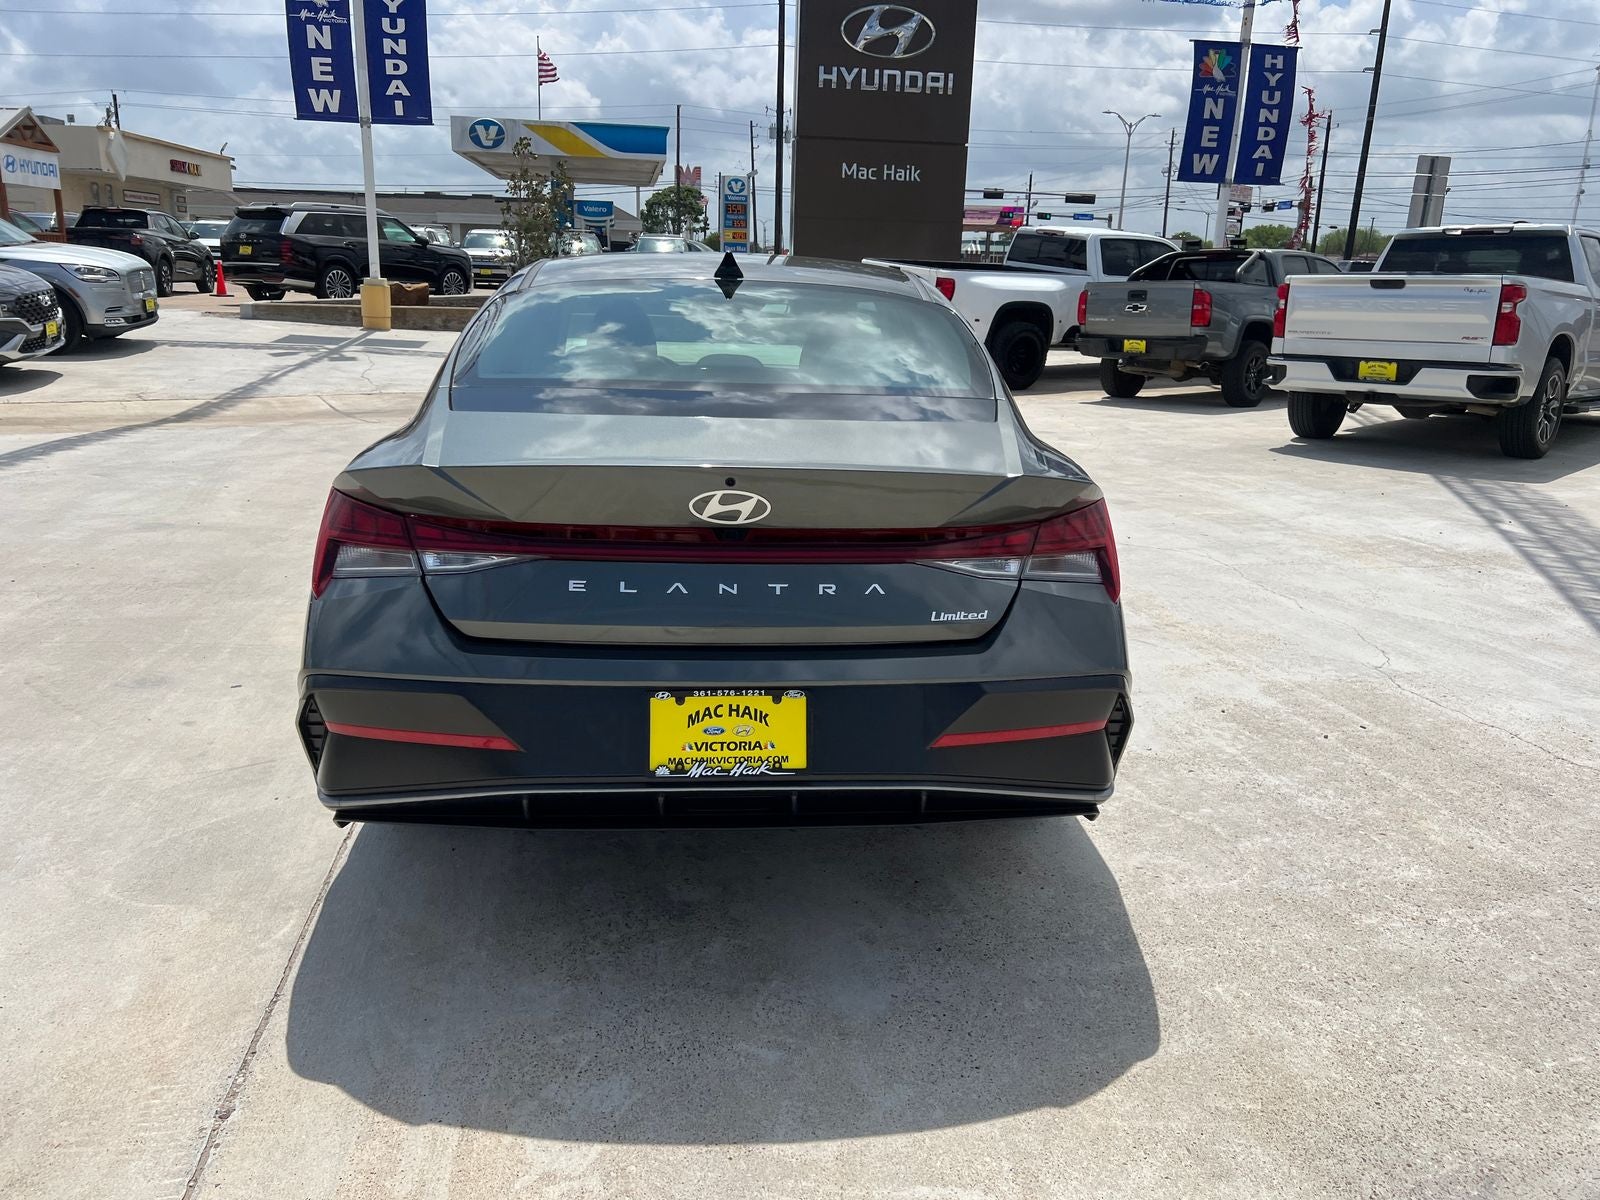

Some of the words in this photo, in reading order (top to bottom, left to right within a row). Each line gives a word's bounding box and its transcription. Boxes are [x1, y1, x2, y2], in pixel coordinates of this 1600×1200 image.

[306, 24, 341, 113] NEW
[818, 65, 954, 95] HYUNDAI
[1252, 53, 1284, 177] HYUNDAI
[1192, 97, 1224, 175] NEW
[19, 158, 58, 178] HYUNDAI
[841, 162, 878, 180] Mac
[883, 164, 921, 182] Haik
[583, 204, 608, 213] Valero
[568, 579, 886, 595] ELANTRA
[931, 610, 989, 622] Limited
[693, 689, 765, 697] 361-576-1221
[687, 703, 724, 728] MAC
[728, 703, 769, 727] HAIK
[693, 741, 763, 752] VICTORIA
[667, 755, 789, 766] MACHAIKVICTORIA.COM
[687, 762, 728, 778] Mac
[729, 761, 776, 777] Haik
